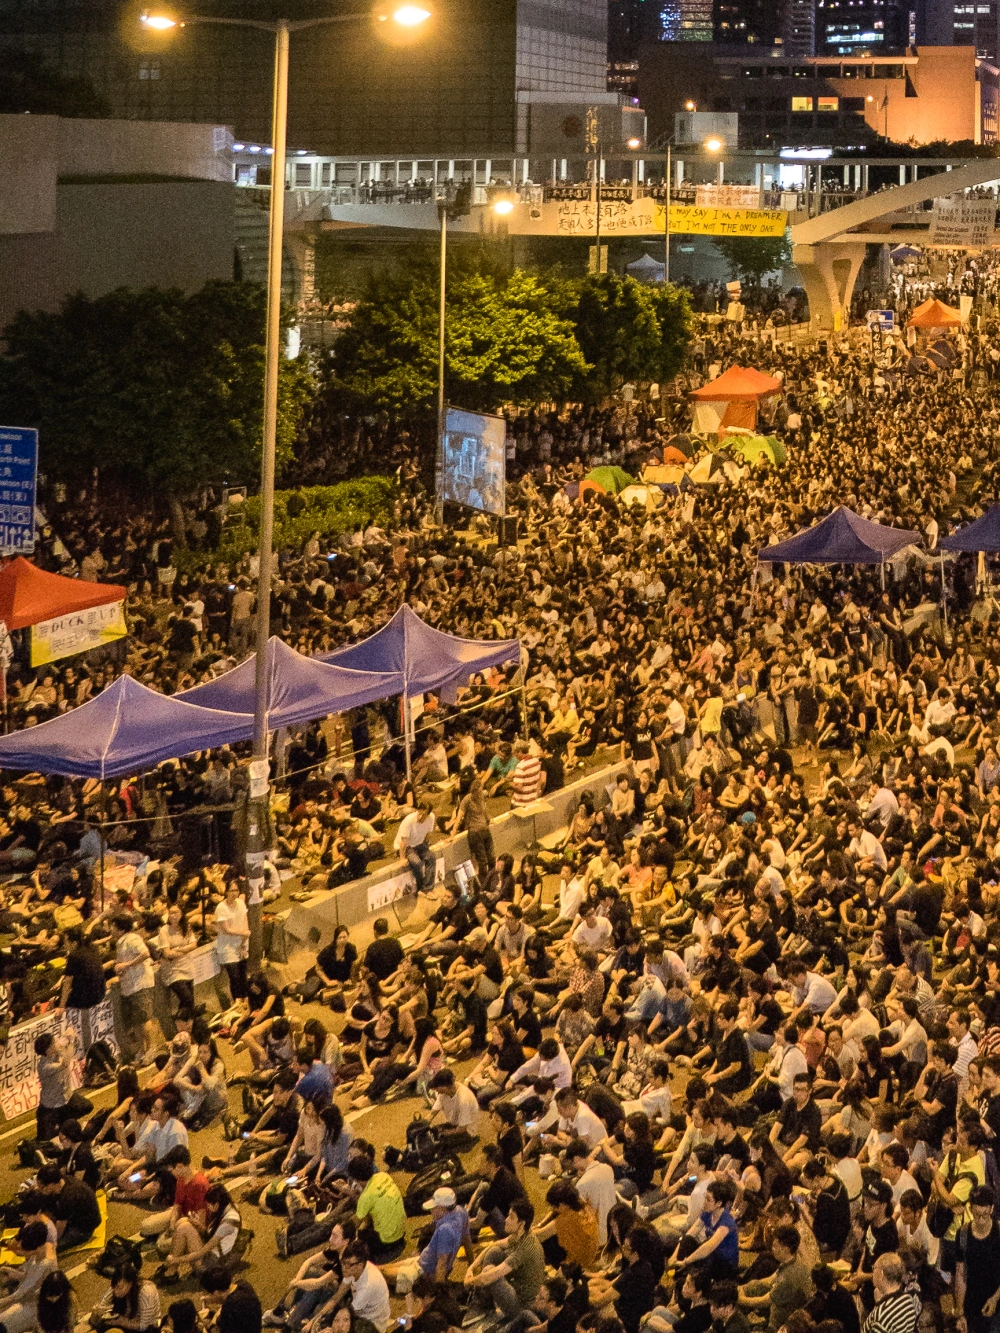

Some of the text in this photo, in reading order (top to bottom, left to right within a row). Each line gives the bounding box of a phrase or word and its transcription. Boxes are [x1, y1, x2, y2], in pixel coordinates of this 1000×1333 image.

[745, 211, 782, 220] DREAMER
[703, 223, 716, 232] NOT
[720, 223, 738, 233] THE
[740, 223, 757, 233] ONLY
[760, 224, 775, 233] ONE
